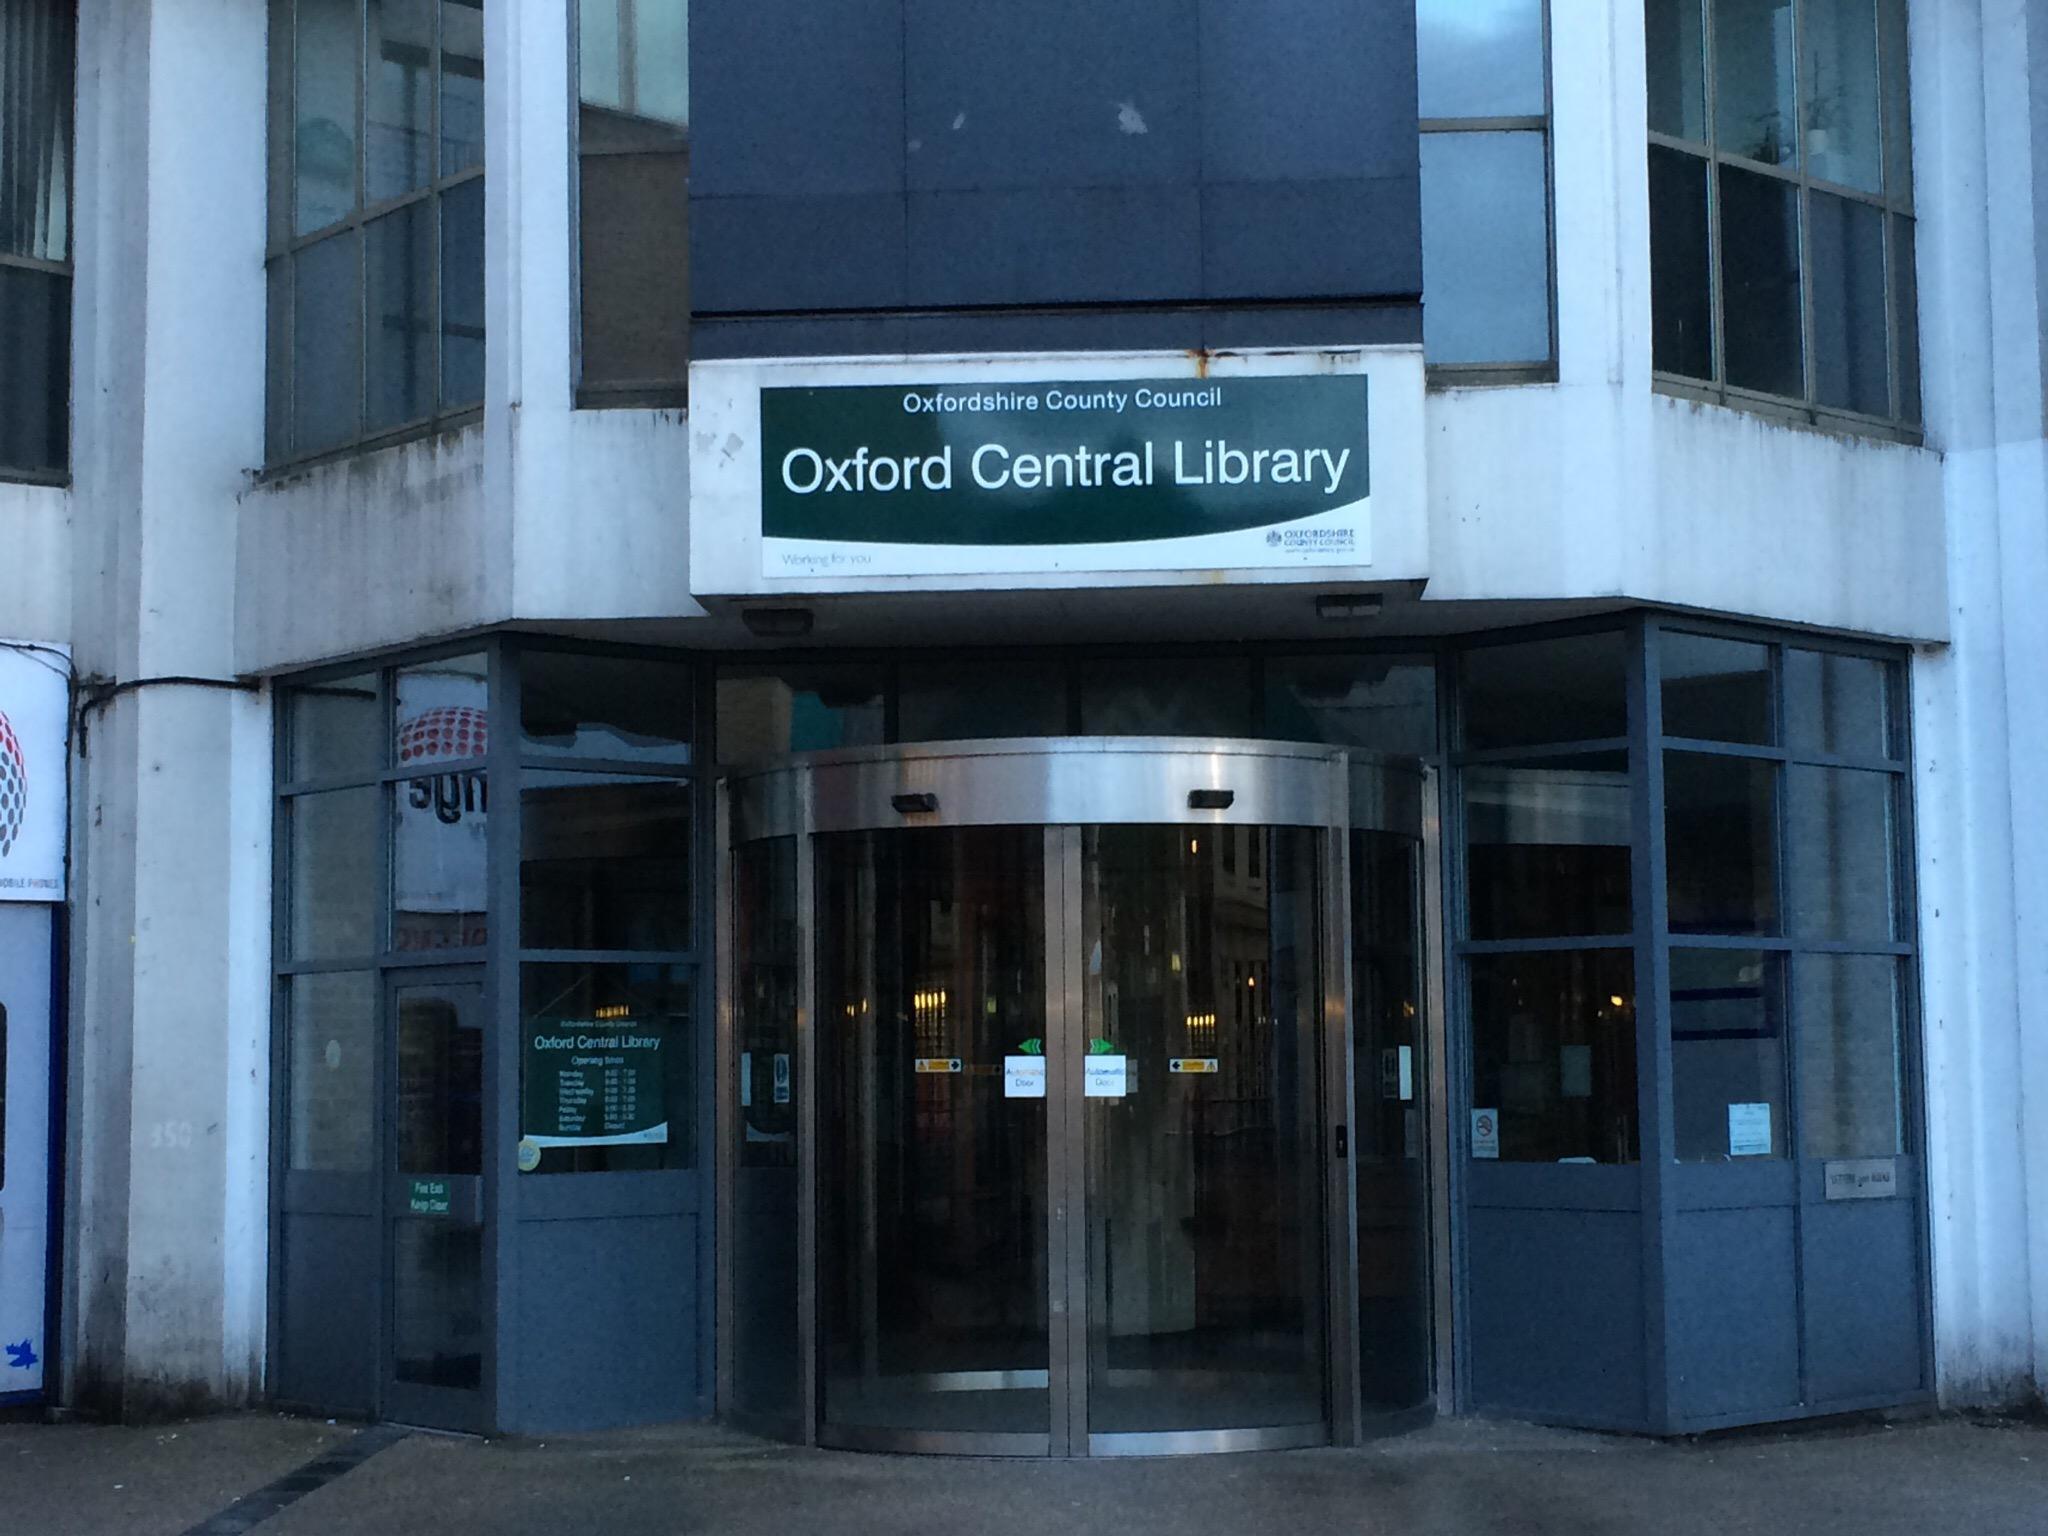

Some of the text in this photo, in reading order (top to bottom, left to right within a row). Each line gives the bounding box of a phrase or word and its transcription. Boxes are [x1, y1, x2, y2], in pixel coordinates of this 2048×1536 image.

[903, 386, 1222, 414] Oxfordshire County Council
[780, 438, 1351, 494] Oxford Central Library
[1284, 529, 1355, 539] OXFORDSHIRE
[1283, 538, 1317, 547] COUNTY
[782, 552, 872, 568] Working for you
[534, 1035, 661, 1051] Oxford Central Library
